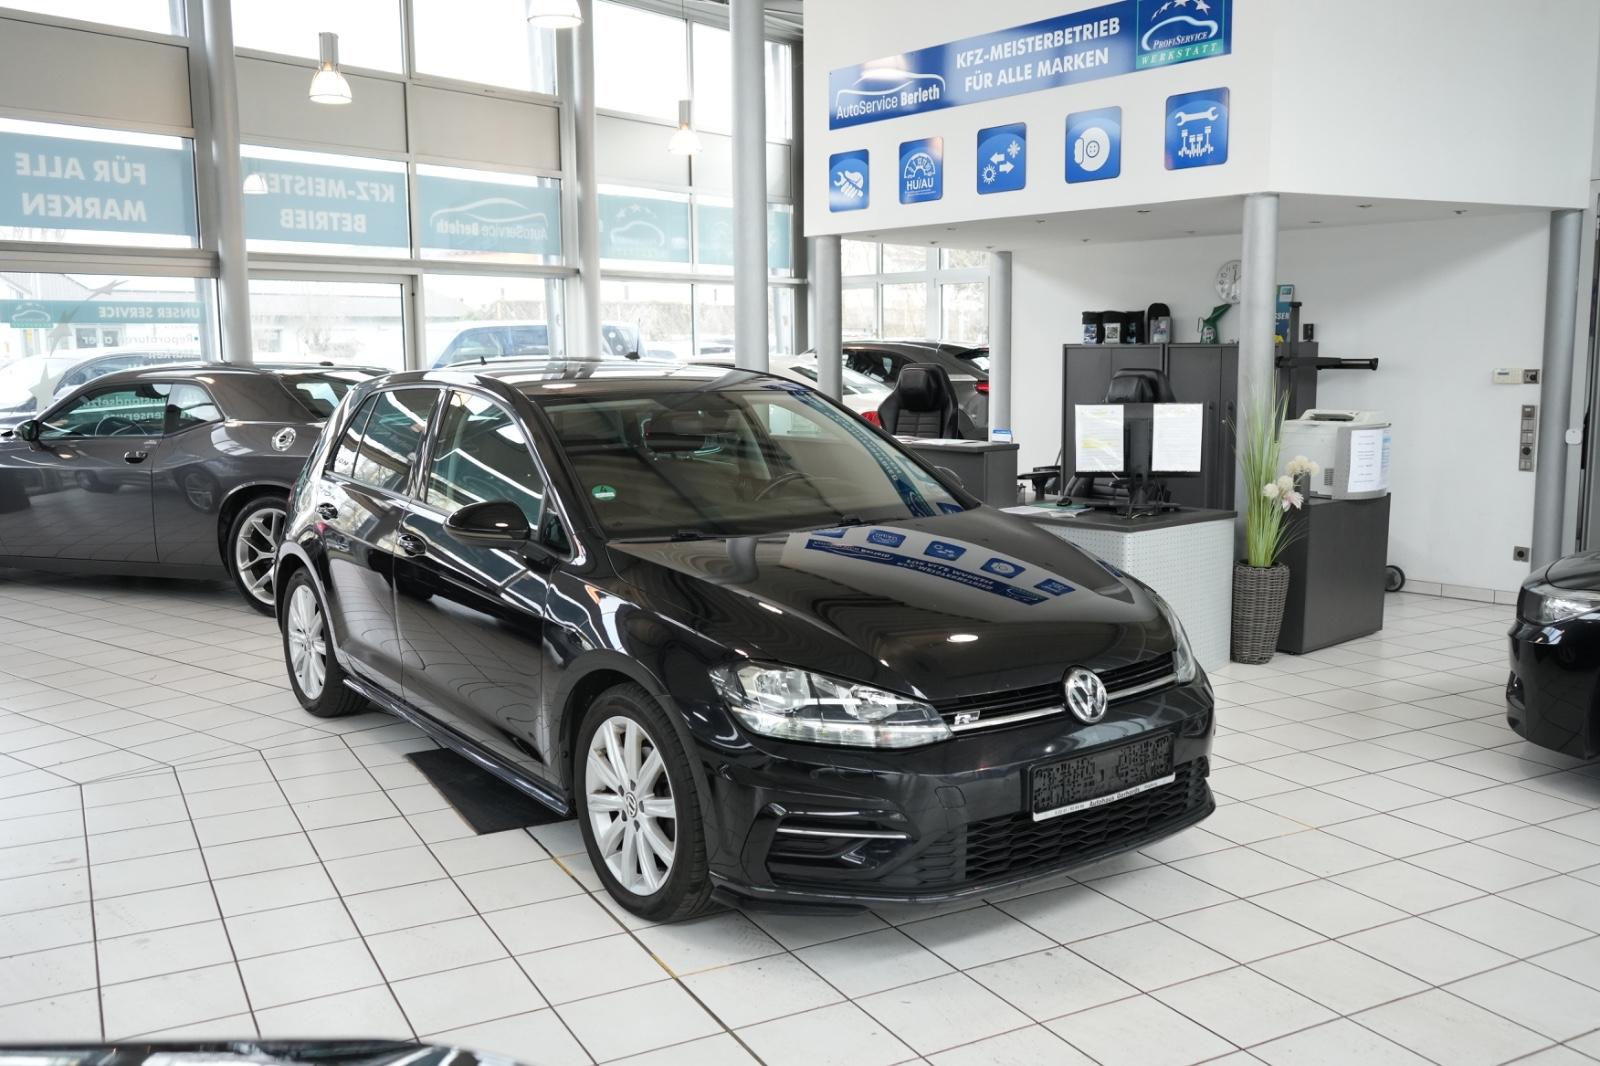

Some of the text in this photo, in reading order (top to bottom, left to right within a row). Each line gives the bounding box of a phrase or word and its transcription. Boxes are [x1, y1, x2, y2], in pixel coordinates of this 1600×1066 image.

[956, 17, 1120, 69] KFZ-MEISTERBETRIEB
[1142, 42, 1218, 65] WERKSTATT
[965, 48, 1109, 92] FÜR ALLE MARKEN
[836, 84, 940, 120] AutoService Berleth
[906, 177, 934, 191] HU/AU
